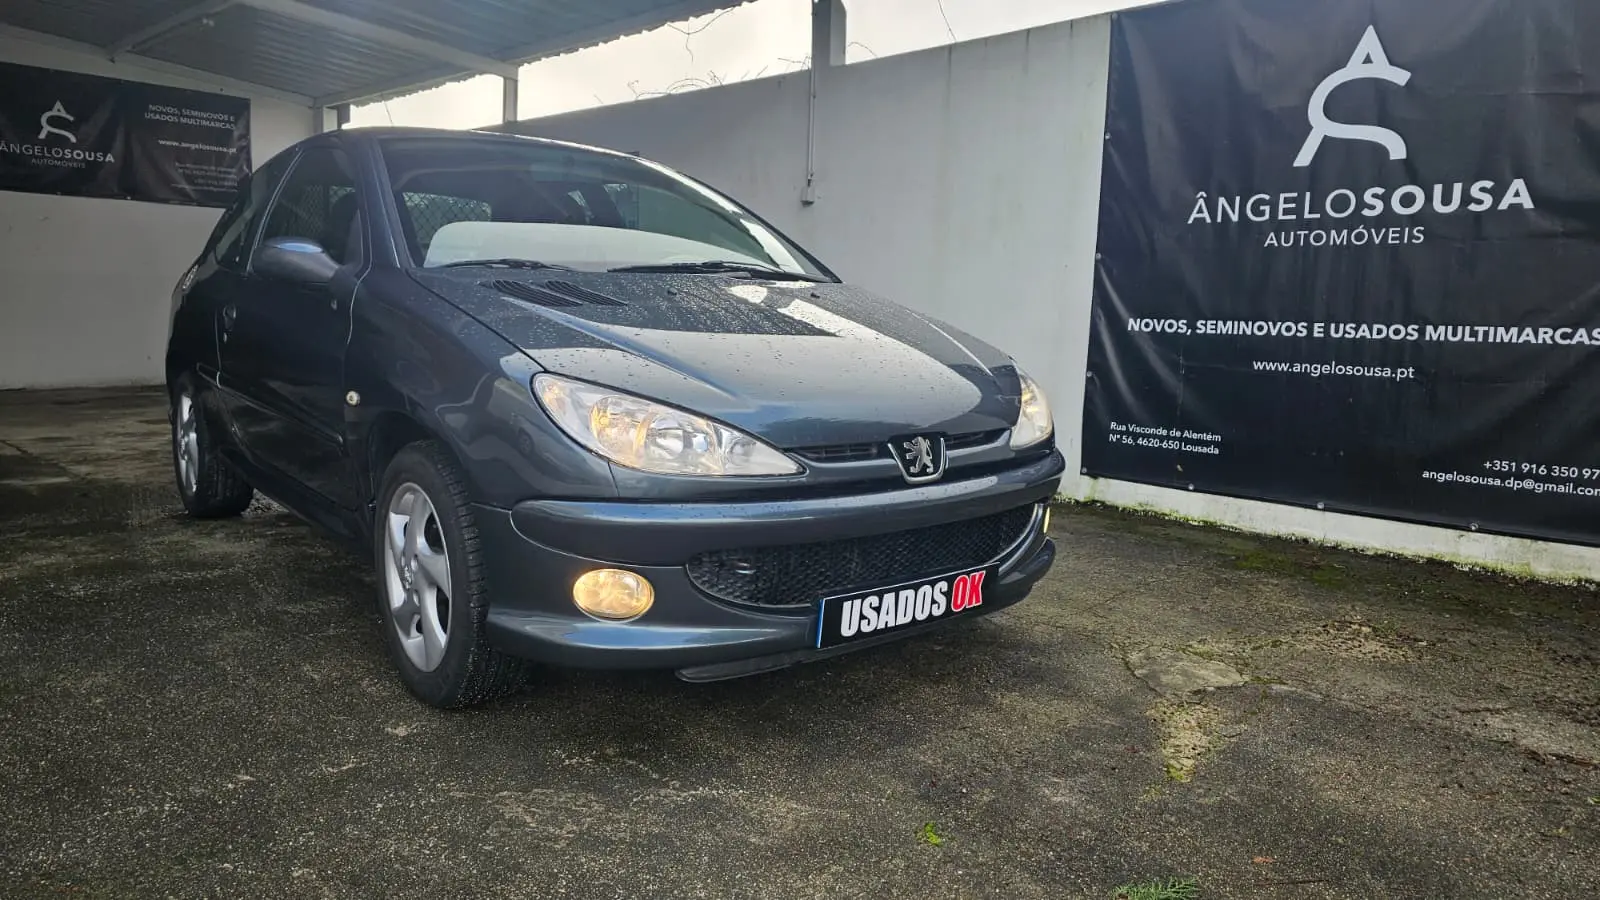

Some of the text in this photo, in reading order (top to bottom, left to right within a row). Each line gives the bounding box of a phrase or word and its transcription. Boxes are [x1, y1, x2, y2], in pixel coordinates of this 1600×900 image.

[1187, 178, 1536, 225] ÂNGELOSOUSA
[1264, 225, 1426, 248] AUTOMÓVEIS
[1127, 318, 1600, 346] NOVOS, SEMINOVOS E USADOS MULTIMARCAS
[1252, 358, 1416, 382] www.angelosousa.pt
[1110, 421, 1222, 442] Rua Visconde de Alentém
[1121, 434, 1136, 446] 56,
[1137, 436, 1180, 450] 4620-650
[1181, 442, 1220, 455] Lousada
[1483, 459, 1517, 473] +351
[1521, 462, 1548, 476] 916
[1551, 465, 1578, 478] 350
[841, 570, 986, 637] USADOS OK
